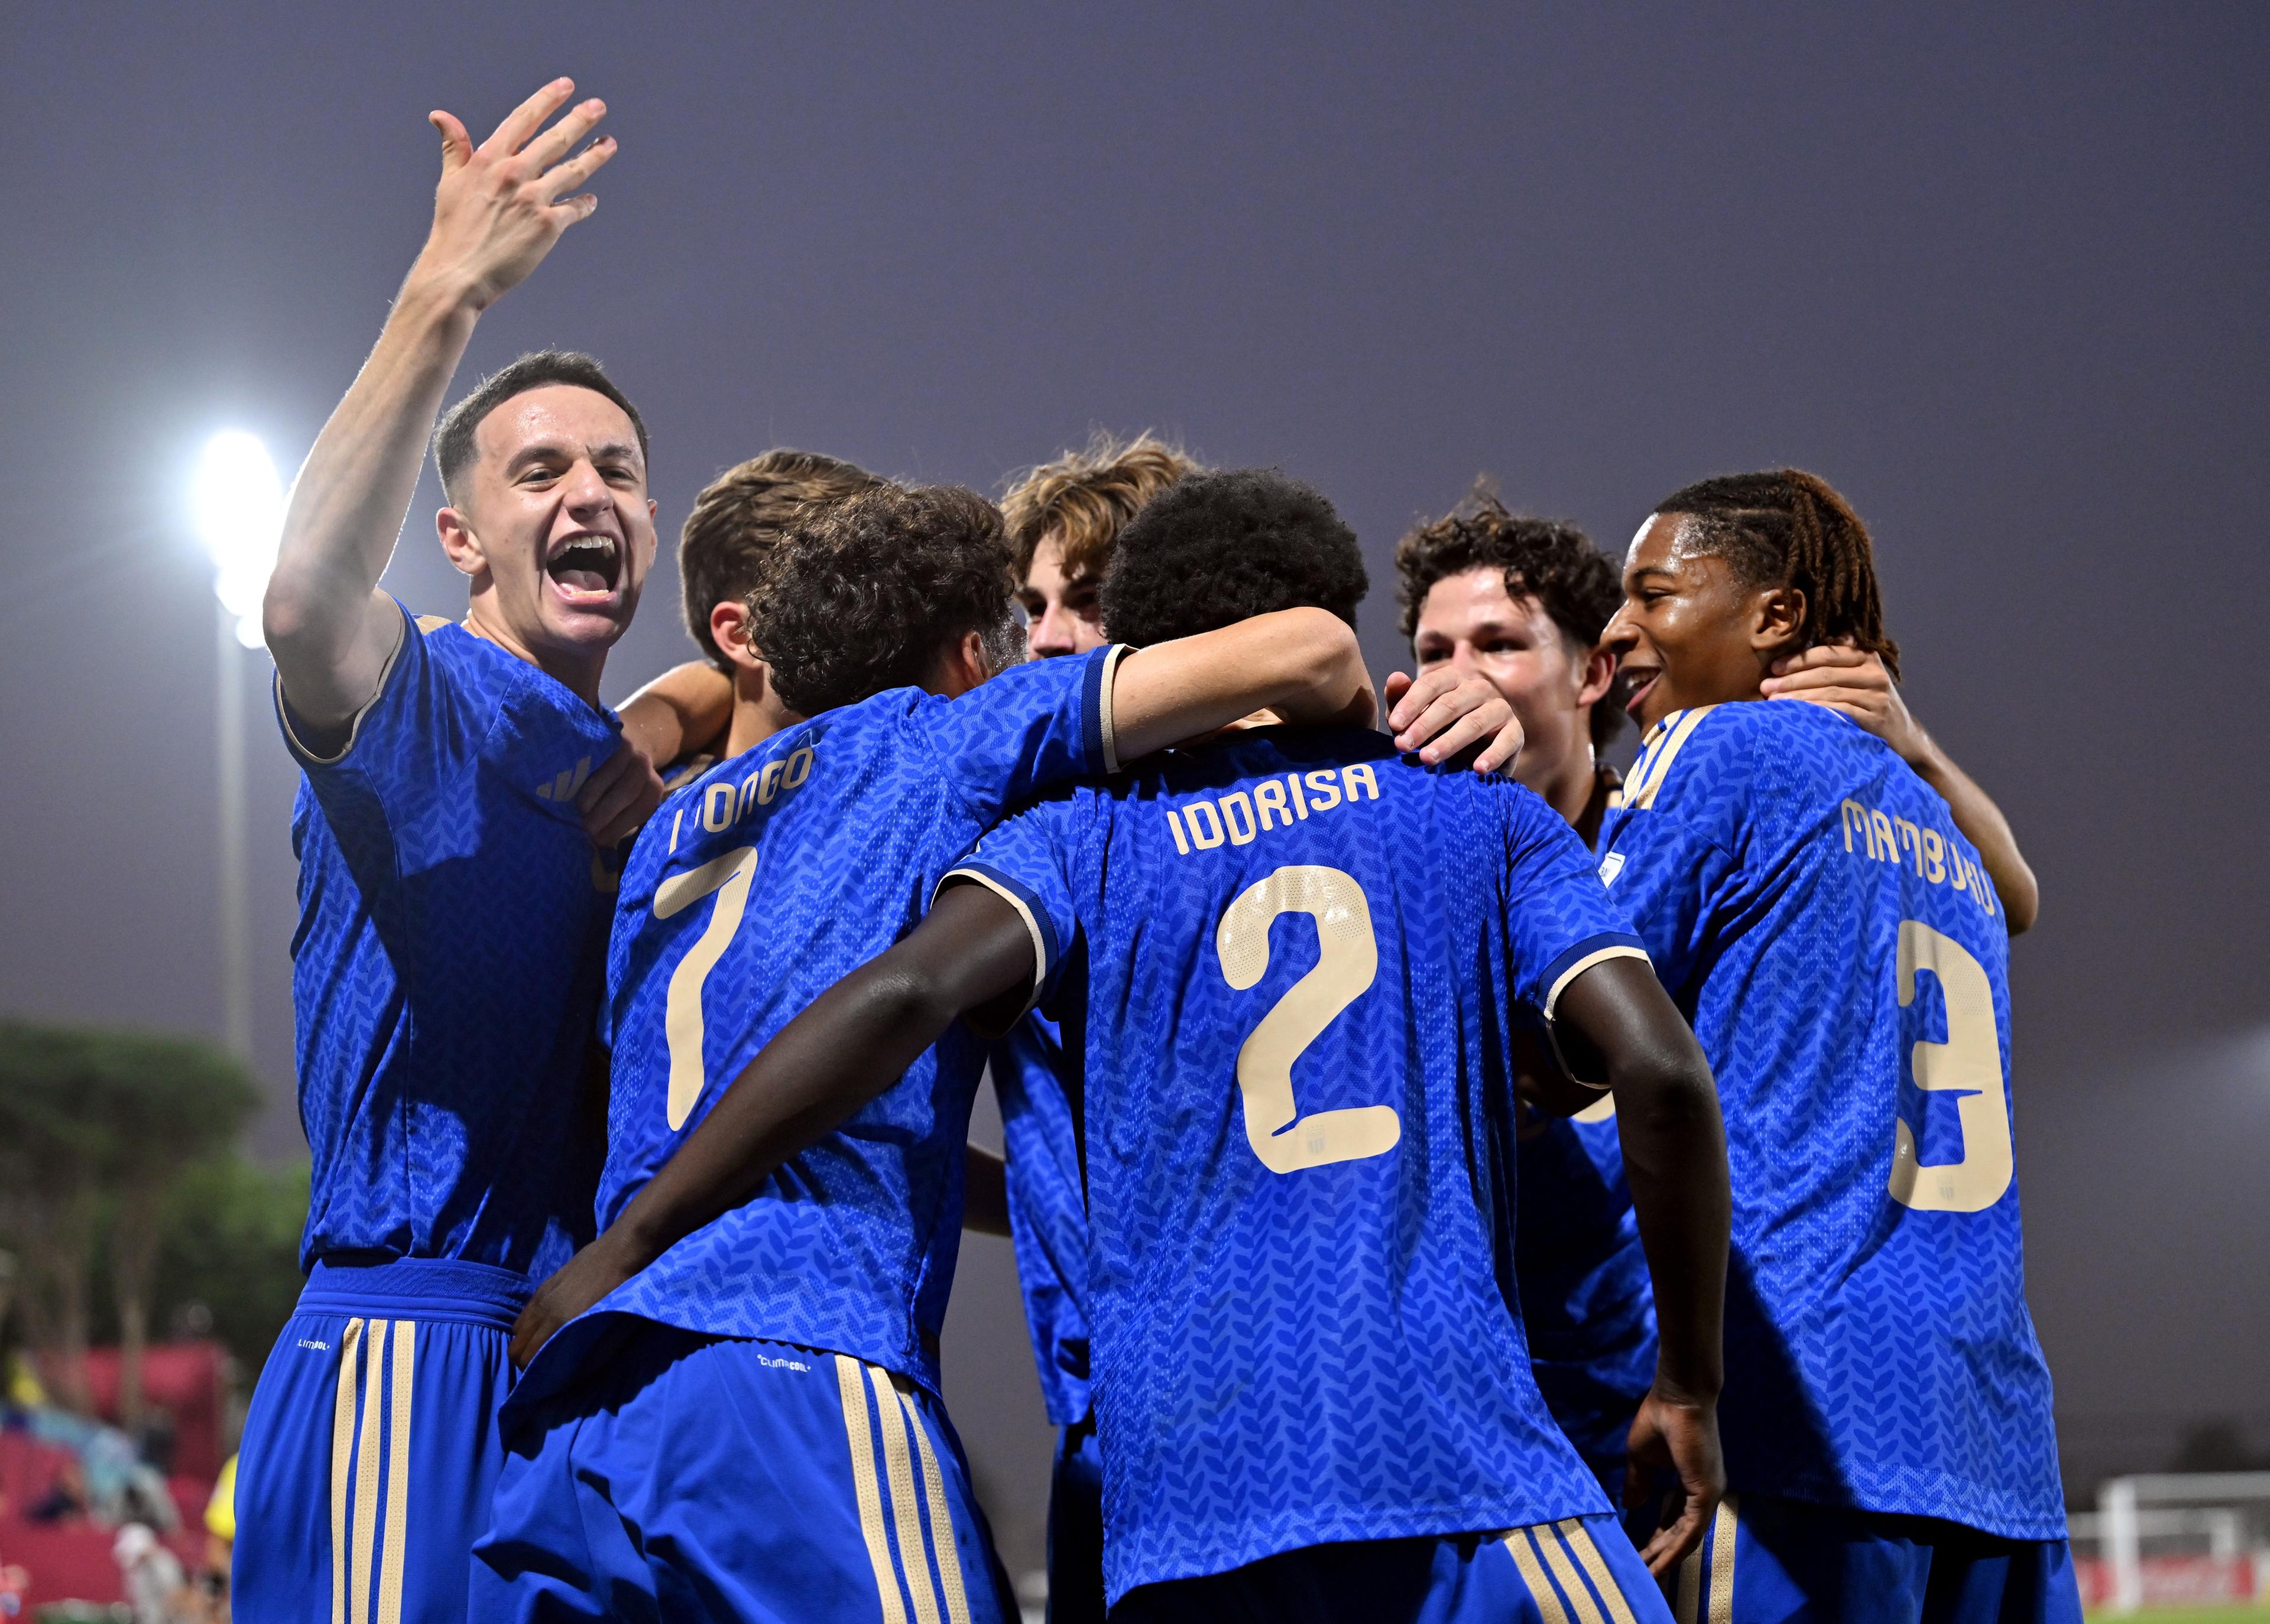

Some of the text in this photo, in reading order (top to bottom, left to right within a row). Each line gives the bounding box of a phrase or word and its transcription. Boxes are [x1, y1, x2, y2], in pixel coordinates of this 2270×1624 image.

[1166, 763, 1380, 855] IDDRISA
[653, 846, 758, 1132] 7
[1216, 865, 1401, 1175] 2
[1888, 920, 2013, 1213] 3
